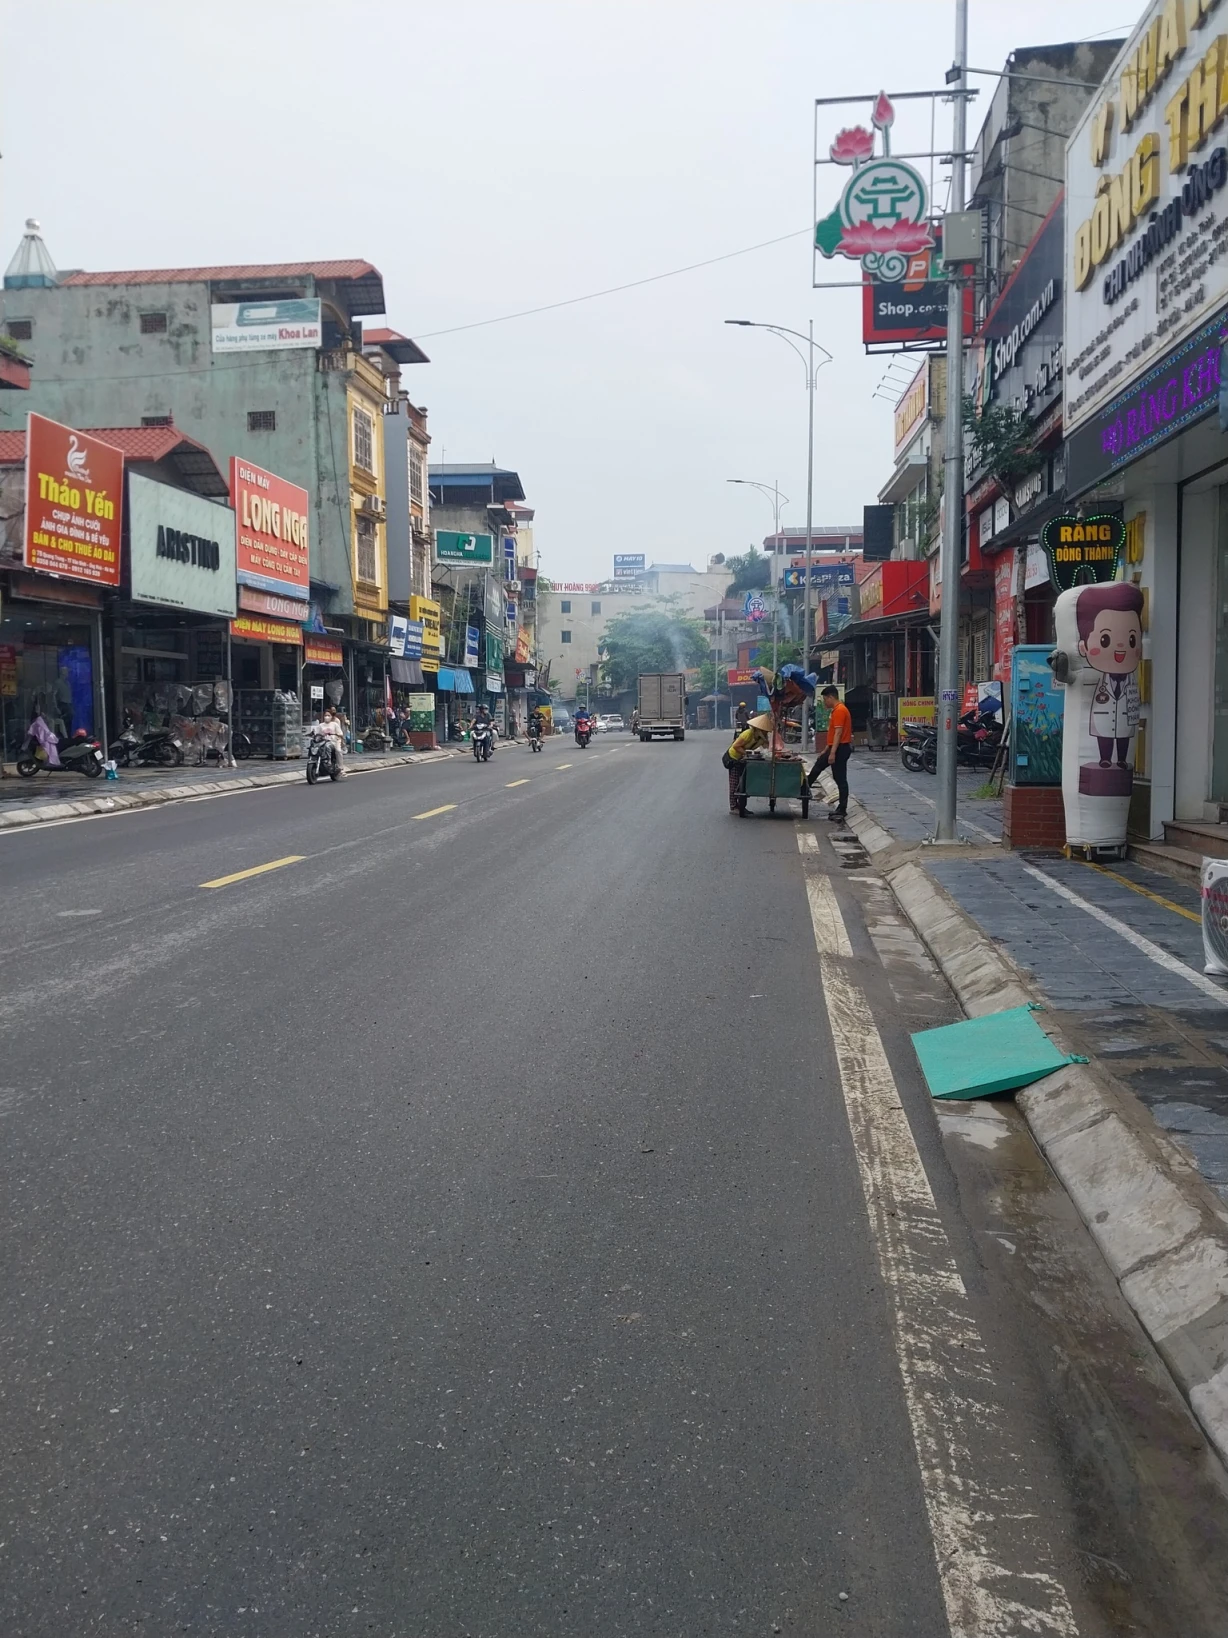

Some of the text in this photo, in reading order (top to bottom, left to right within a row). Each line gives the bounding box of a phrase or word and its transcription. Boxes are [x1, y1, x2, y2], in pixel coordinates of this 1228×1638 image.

[1103, 259, 1127, 305] CHI
[1125, 196, 1182, 283] NHÁNH
[278, 327, 300, 340] Khoa
[302, 326, 318, 338] Lan
[994, 278, 1054, 380] Shop.com.vn
[239, 467, 270, 491] ĐIỆN MÁY
[38, 473, 80, 510] Thảo
[85, 489, 114, 520] Yến
[41, 516, 56, 532] ẢNH
[52, 509, 70, 525] CHỤP
[71, 512, 85, 528] ẢNH
[241, 489, 308, 549] LONG NGA
[1060, 523, 1111, 542] RĂNG
[33, 530, 49, 546] BÁN
[50, 535, 57, 548] &
[57, 537, 73, 552] CHO
[93, 546, 103, 560] ÁO
[156, 525, 219, 573] ARISTINO
[1056, 545, 1081, 562] ĐÔNG
[1084, 544, 1114, 560] THÀNH
[552, 582, 563, 591] HUY
[564, 581, 584, 591] HOÀNG
[266, 597, 289, 614] LONG
[292, 603, 309, 618] NGA
[251, 621, 266, 634] MÁY
[267, 622, 286, 636] LONG
[286, 627, 300, 638] NGA
